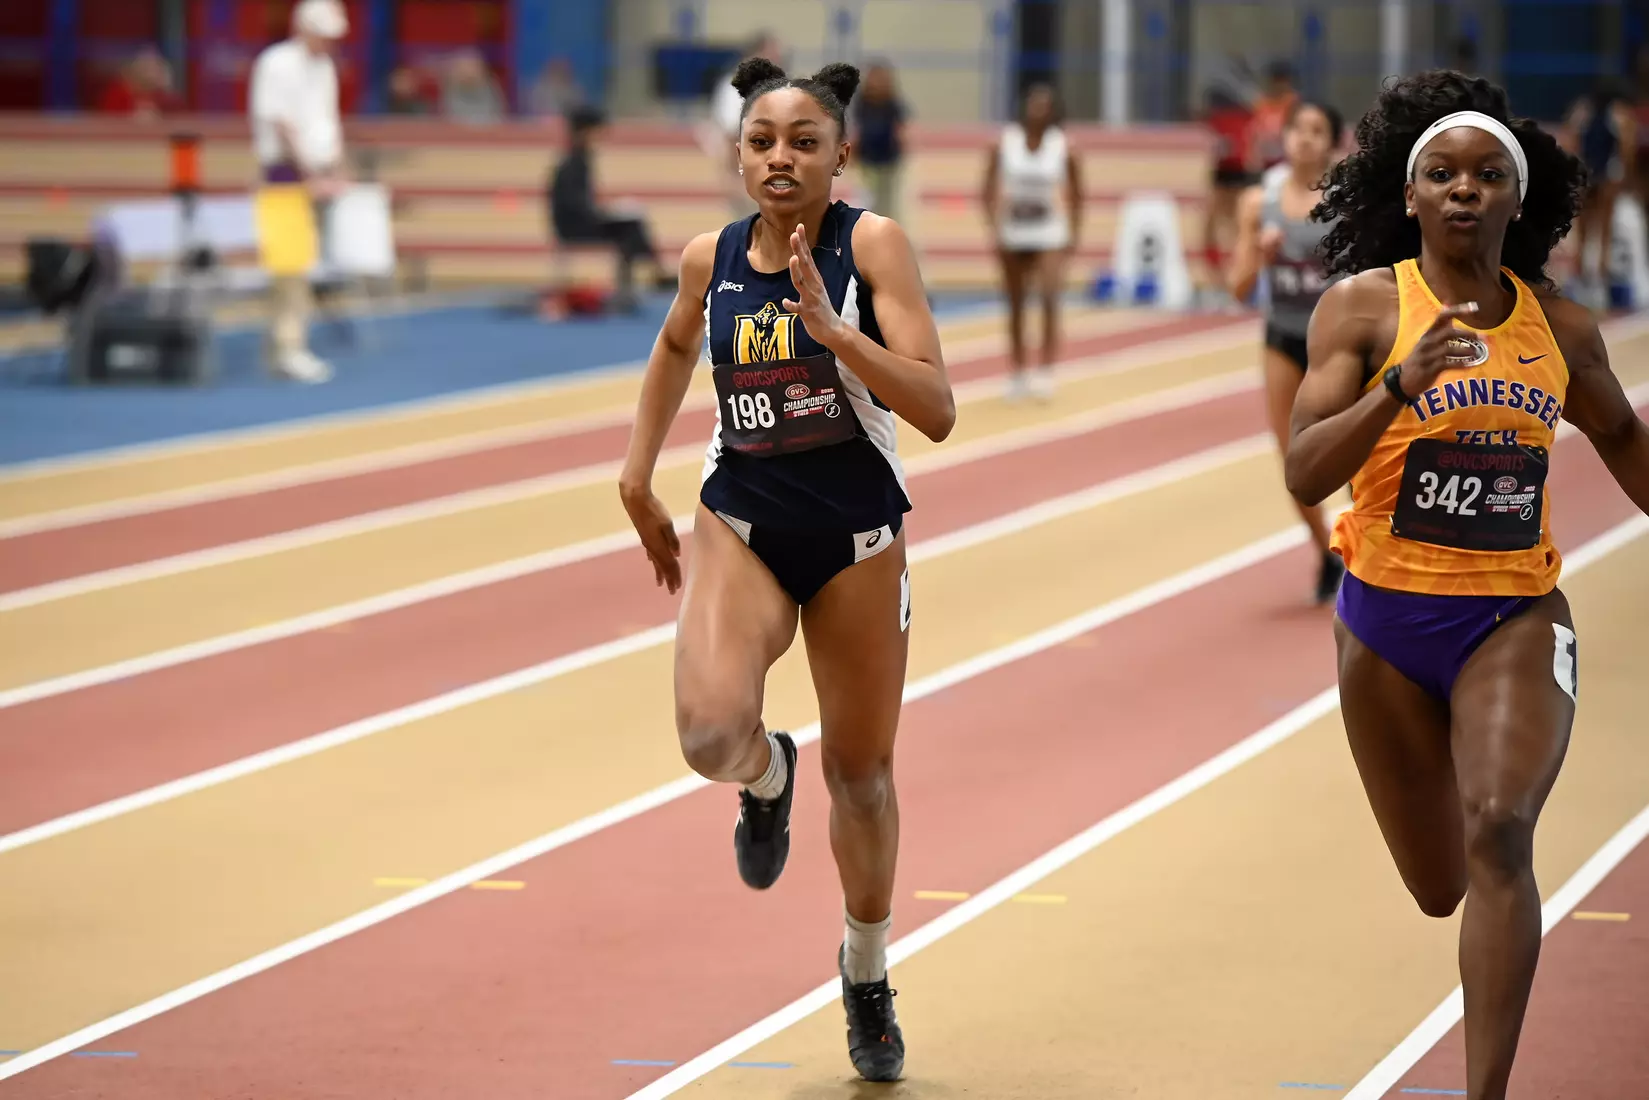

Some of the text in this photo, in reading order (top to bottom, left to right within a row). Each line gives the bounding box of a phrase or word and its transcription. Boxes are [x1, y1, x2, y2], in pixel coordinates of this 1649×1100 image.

[733, 366, 809, 388] @OVCSPORTS
[727, 392, 775, 429] 198
[783, 393, 836, 412] CHAMPIONSHIP
[1410, 378, 1562, 430] TENNESSEE
[1438, 452, 1526, 472] @OVCSPORTS
[1415, 471, 1482, 516] 342
[1485, 493, 1536, 504] CHAMPIONSHIP
